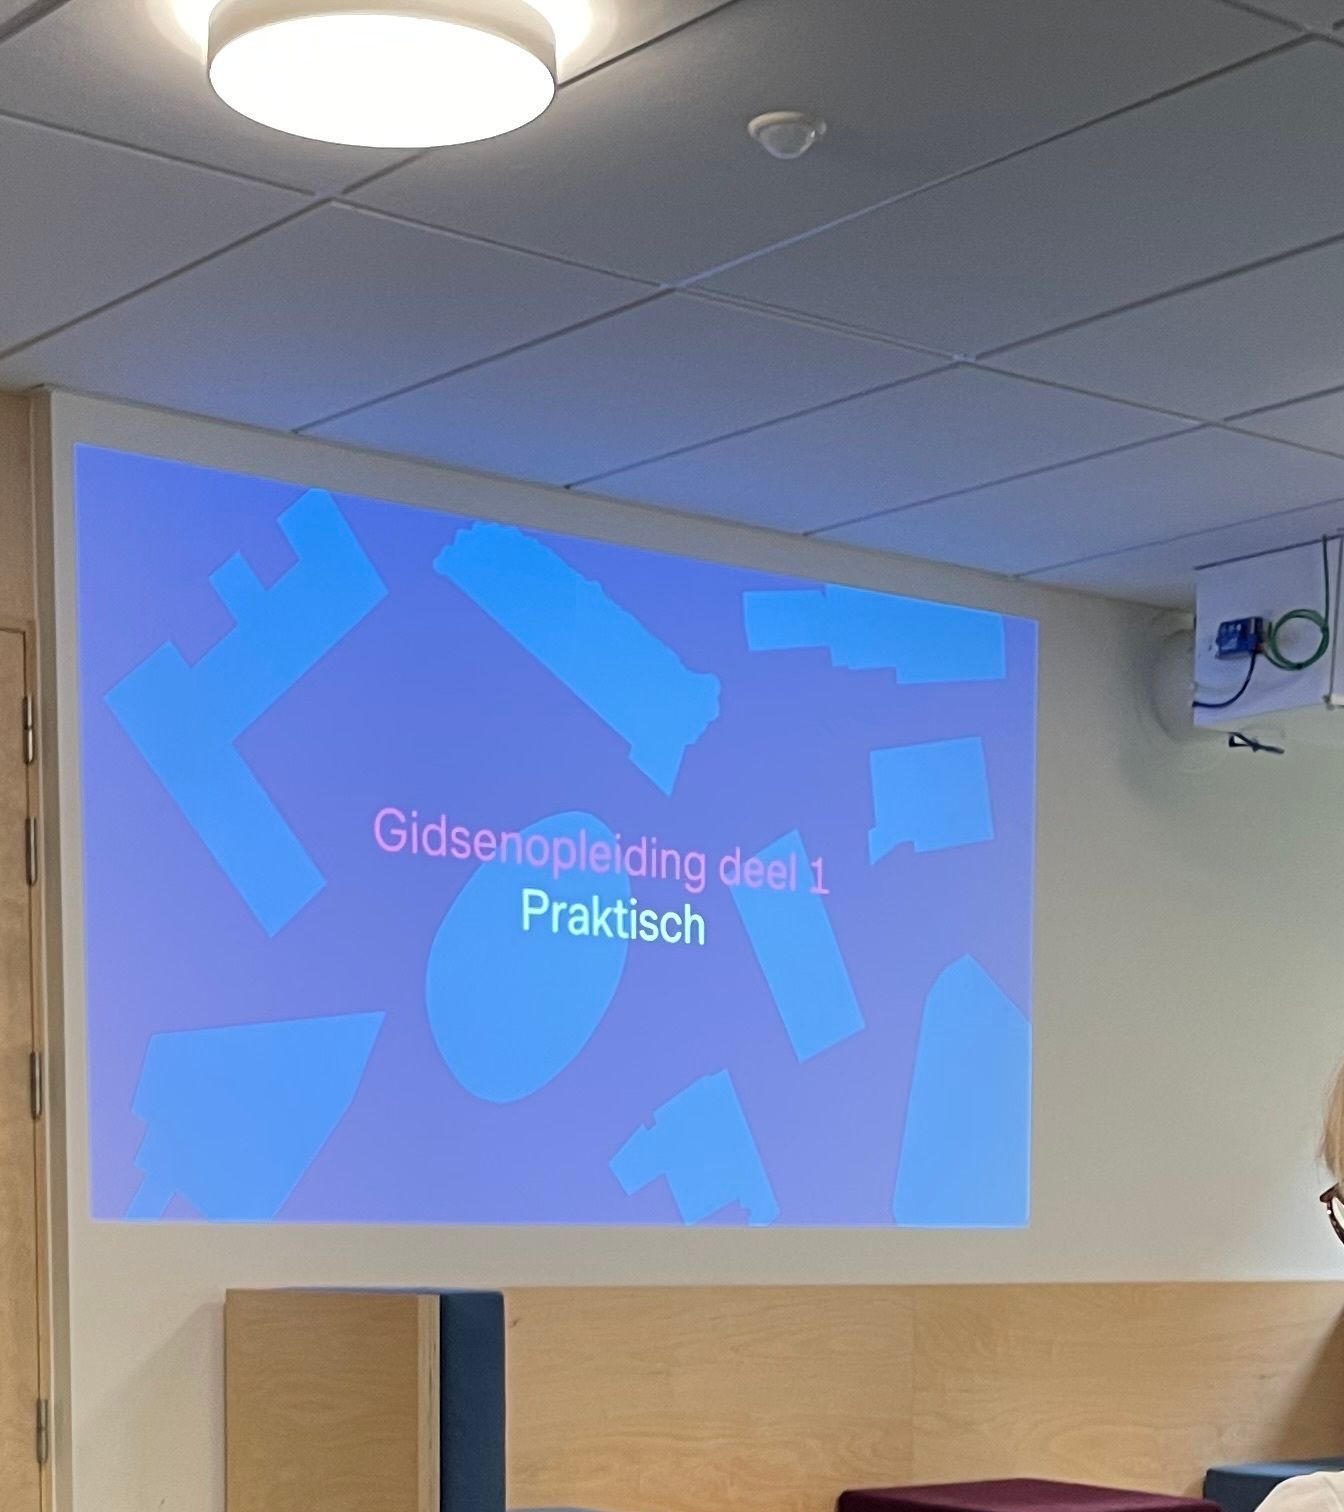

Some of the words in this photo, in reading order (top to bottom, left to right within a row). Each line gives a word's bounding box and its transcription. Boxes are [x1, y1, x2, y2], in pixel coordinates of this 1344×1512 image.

[373, 806, 706, 894] Gidsenopleiding
[719, 846, 797, 891] deel
[809, 856, 831, 895] 1
[521, 887, 706, 946] Praktisch
